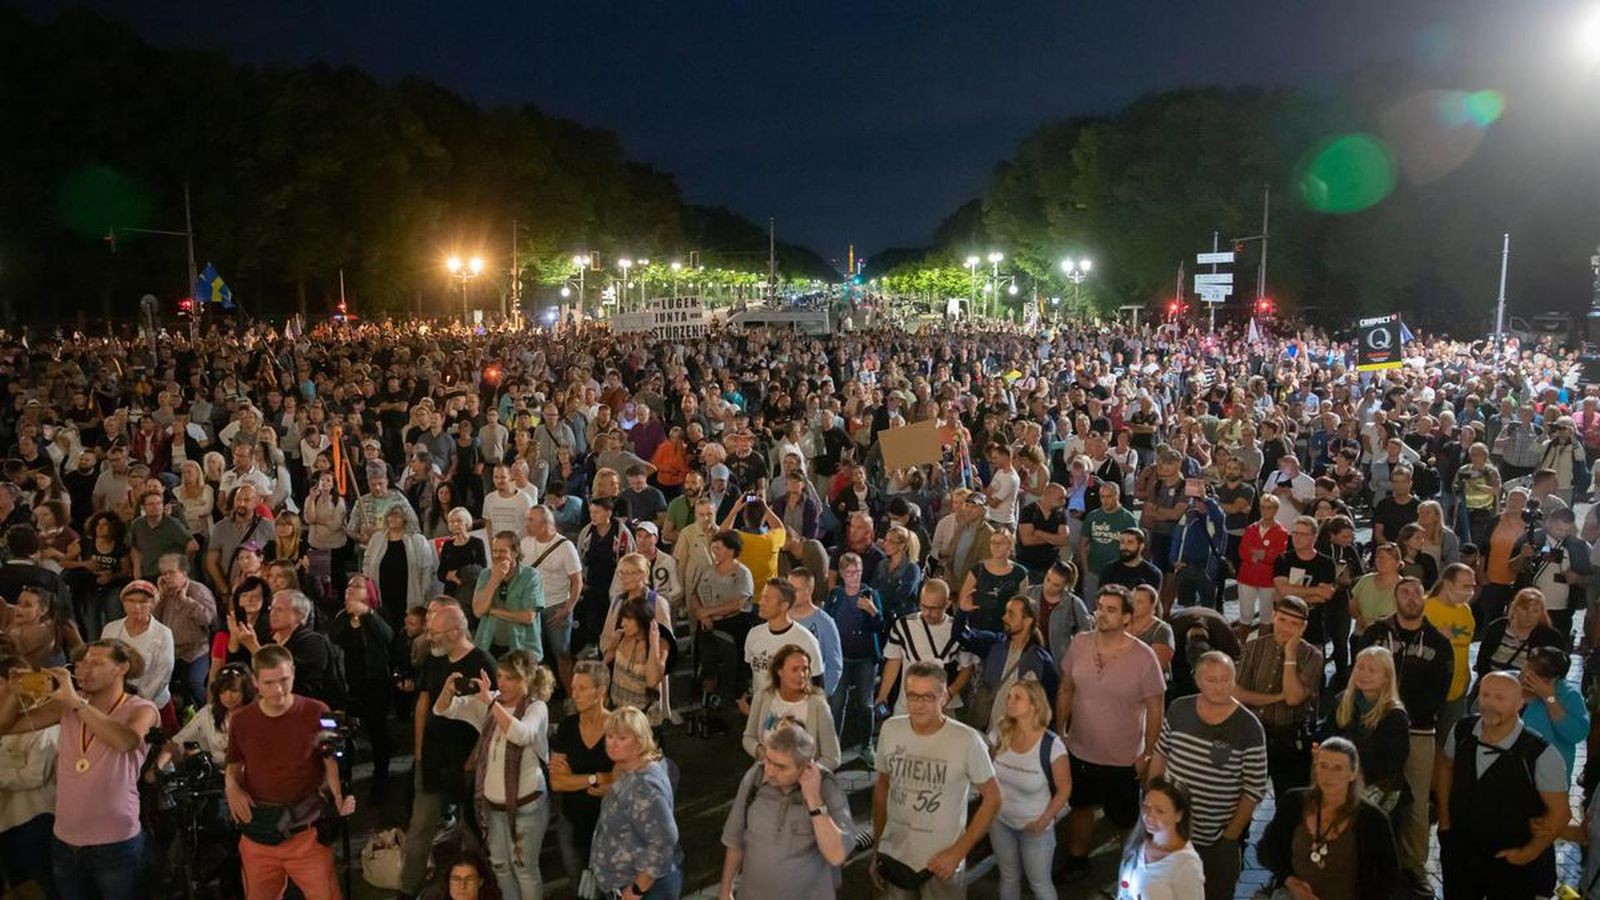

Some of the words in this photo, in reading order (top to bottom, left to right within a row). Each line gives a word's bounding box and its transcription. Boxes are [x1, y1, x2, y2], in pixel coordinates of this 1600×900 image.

[655, 312, 687, 323] JUNTA
[1367, 328, 1393, 350] Q
[655, 567, 669, 587] 9
[888, 757, 947, 785] STREAM
[912, 790, 943, 813] 56
